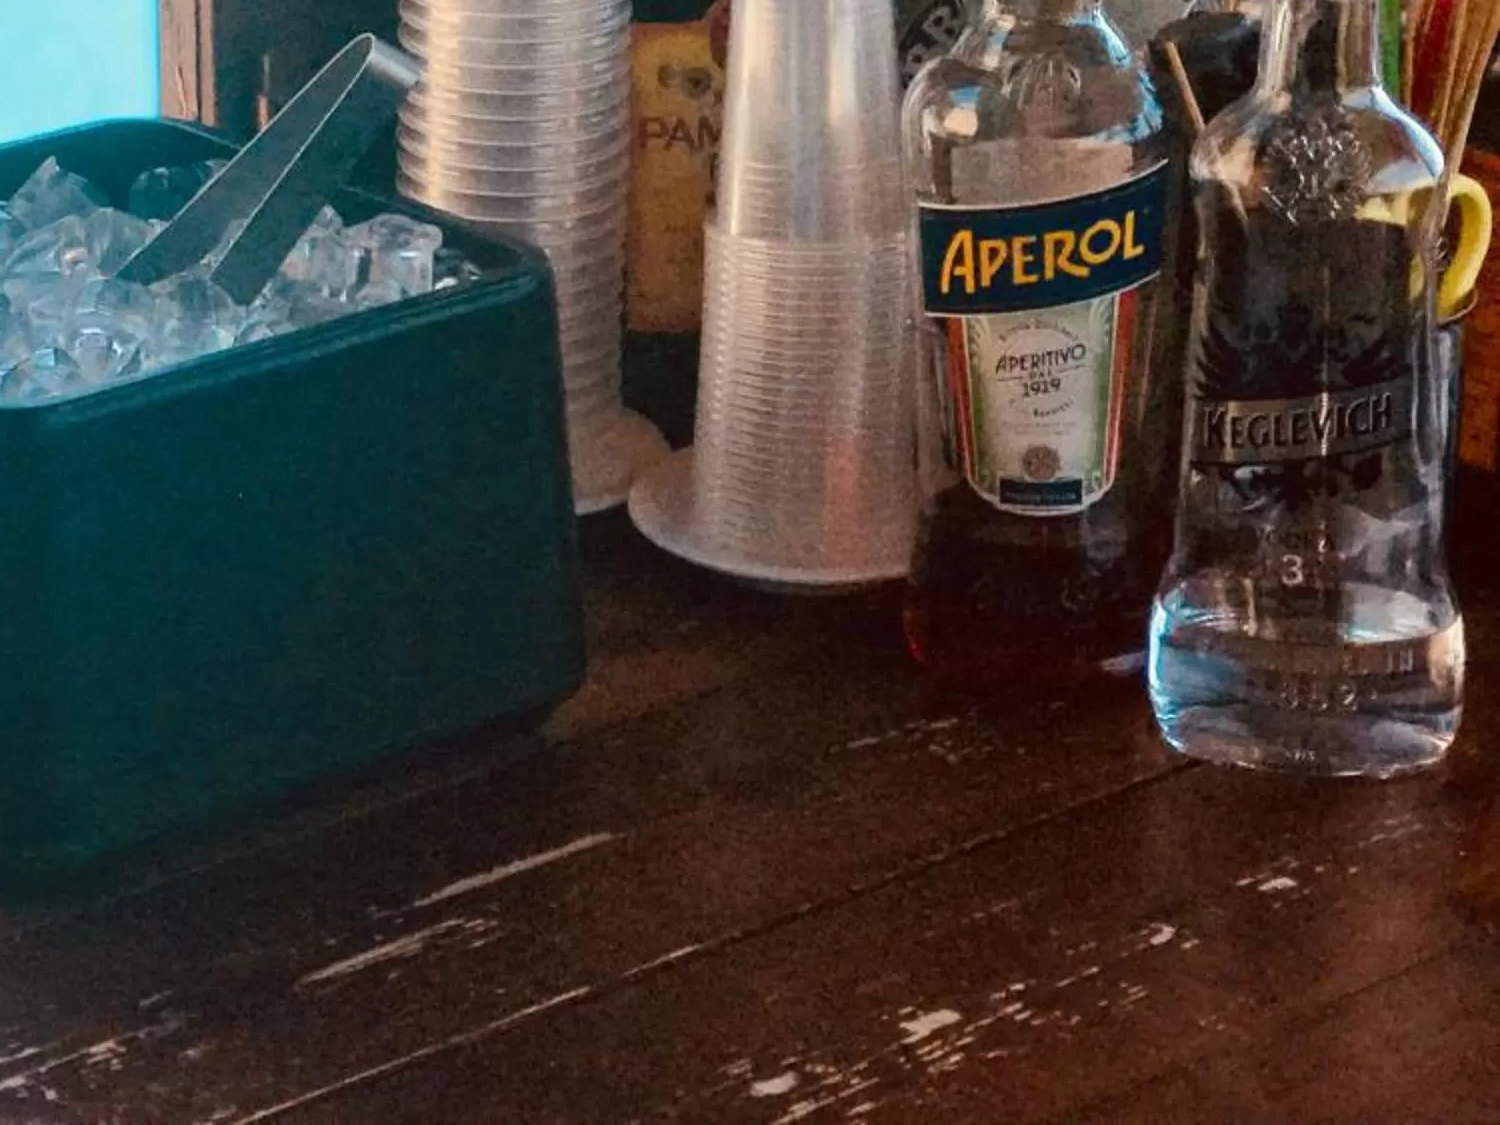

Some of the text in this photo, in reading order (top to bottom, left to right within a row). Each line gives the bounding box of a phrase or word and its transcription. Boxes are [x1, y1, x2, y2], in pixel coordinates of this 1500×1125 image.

[940, 210, 1145, 295] APEROL
[996, 343, 1086, 374] APERITIVO
[1021, 377, 1061, 397] 1919
[1203, 392, 1392, 448] KEGLEVICH
